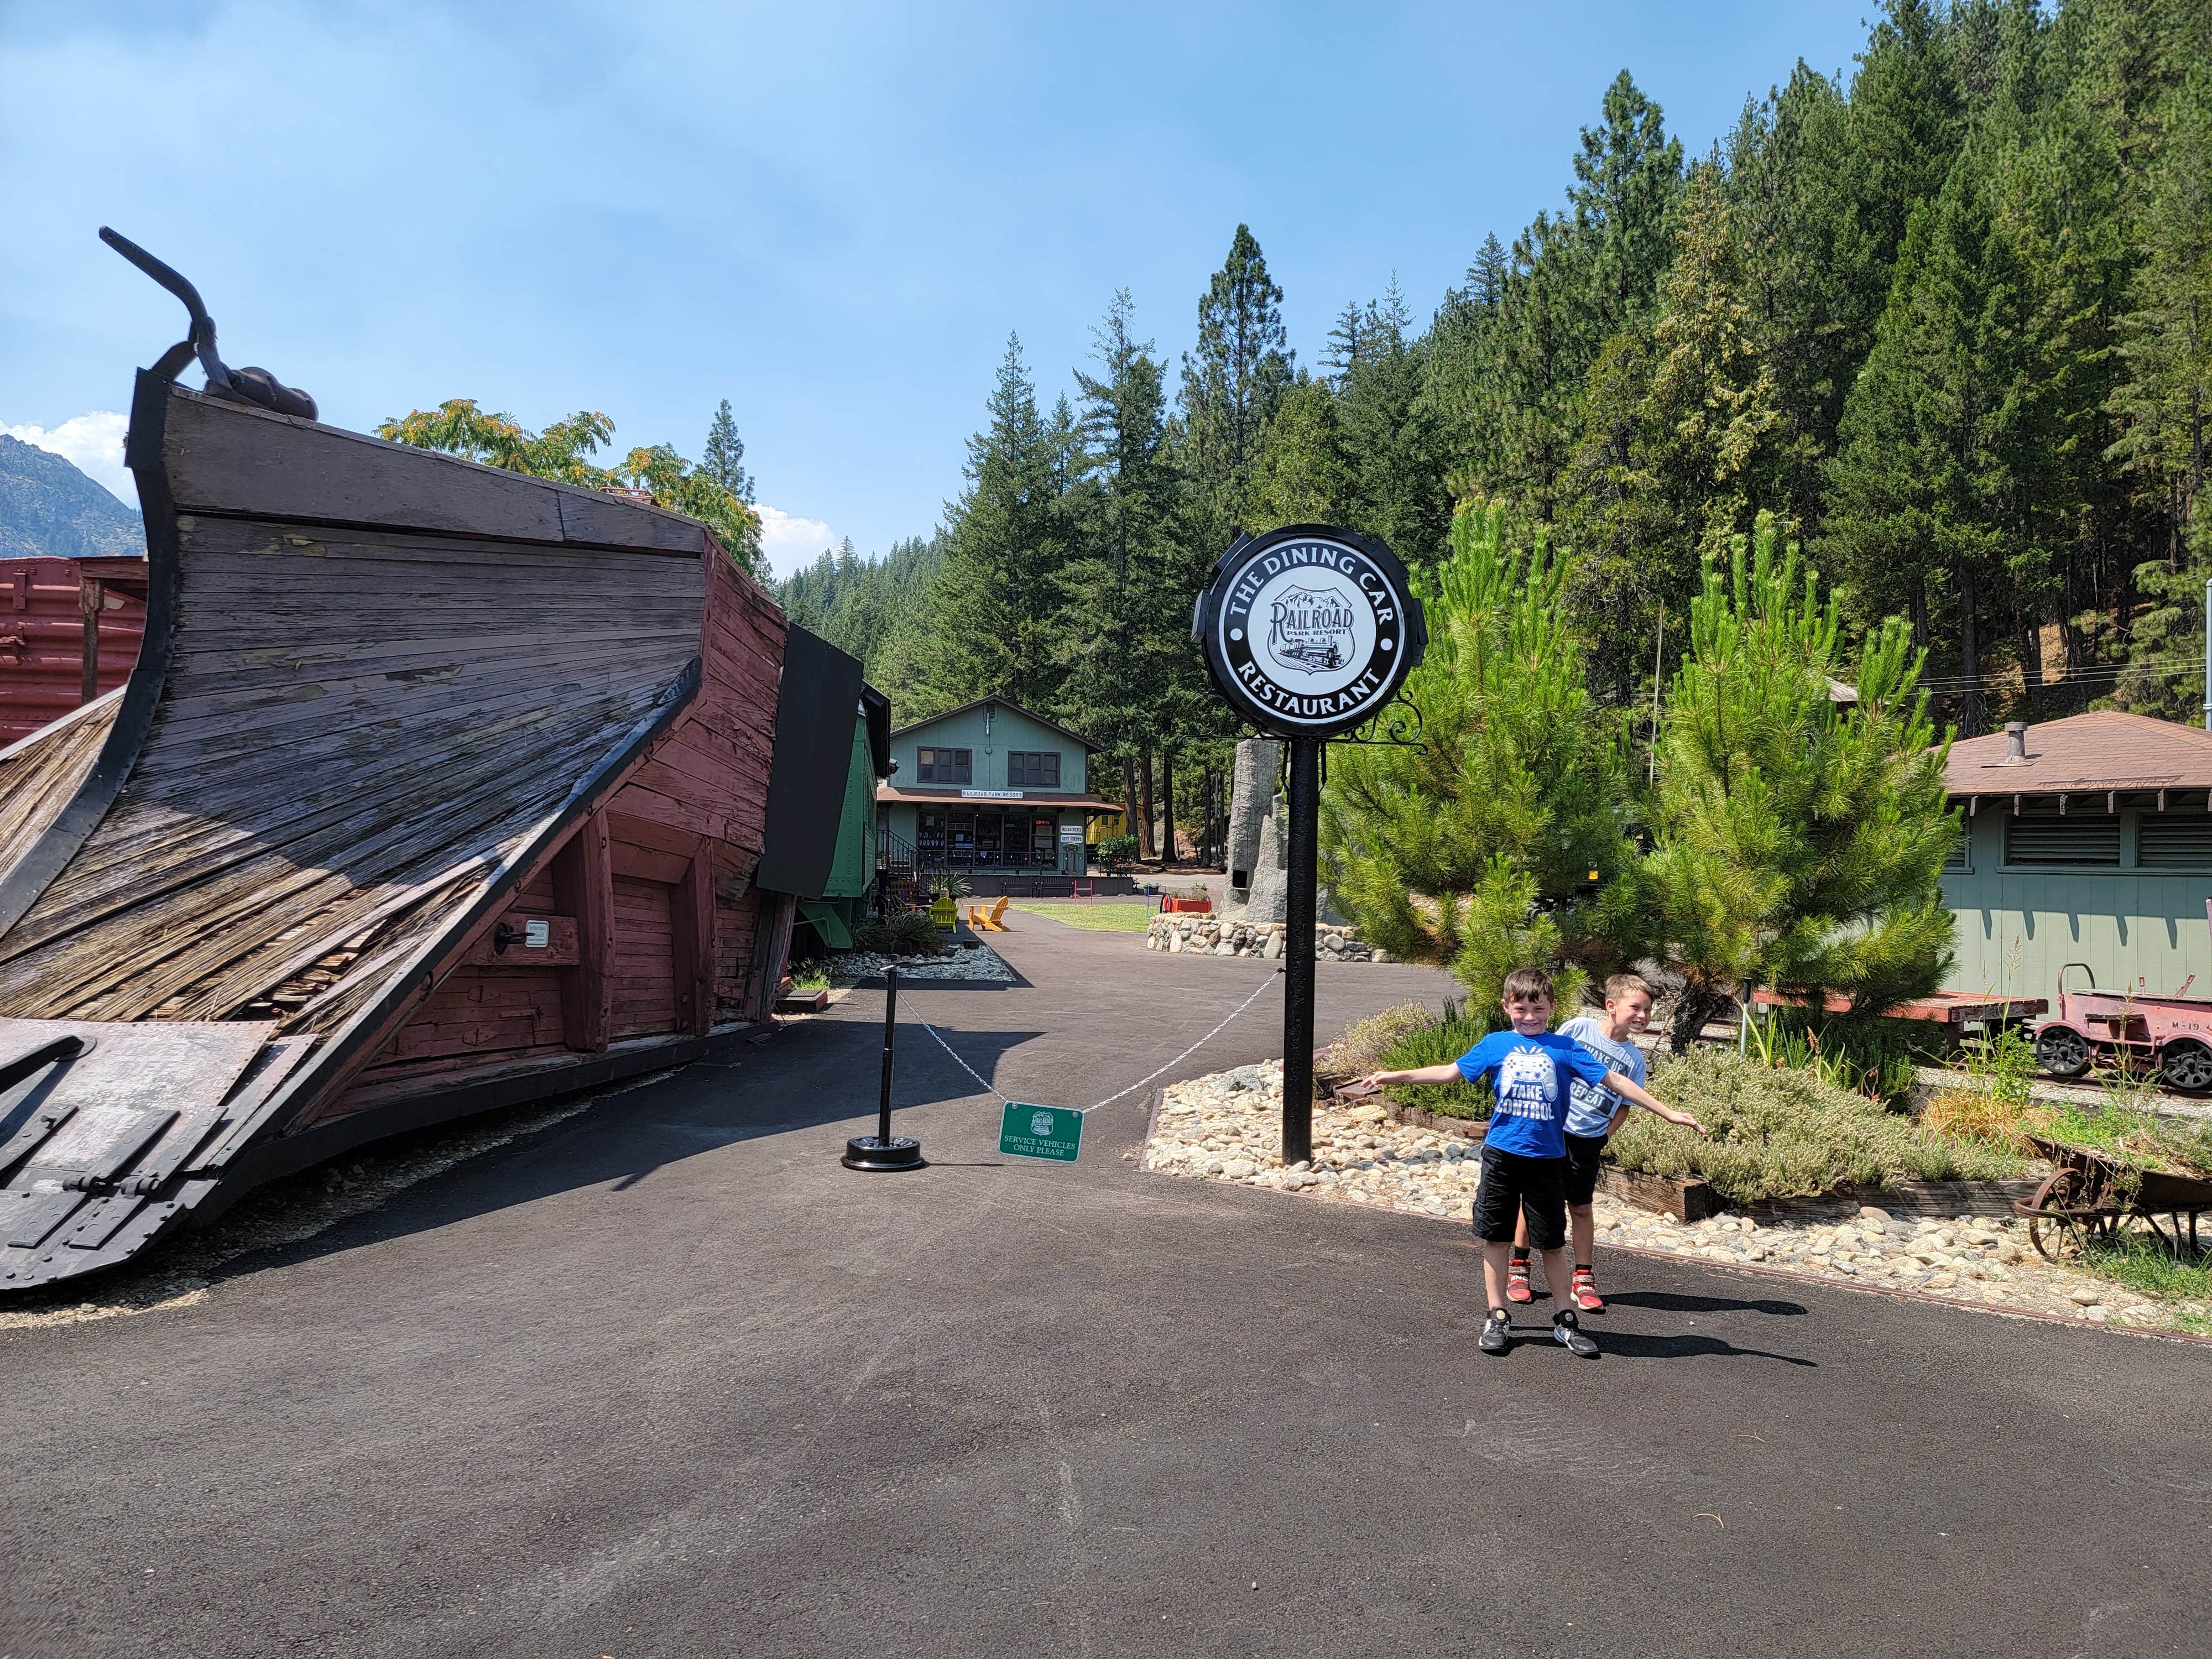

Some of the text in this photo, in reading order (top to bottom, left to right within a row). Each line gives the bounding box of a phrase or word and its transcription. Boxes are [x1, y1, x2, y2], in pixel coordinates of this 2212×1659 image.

[1230, 547, 1394, 626] THE DINING CAR
[1270, 602, 1354, 645] RAILROAD
[1238, 660, 1380, 715] RESTAURANT
[1611, 1060, 1623, 1073] UP
[1511, 1084, 1543, 1100] TAKE
[1570, 1081, 1605, 1107] REPEAT
[1496, 1098, 1554, 1120] CONTROL
[1004, 1135, 1076, 1150] SERVICE VEHICLES
[1014, 1144, 1065, 1156] ONLY PLEASE
